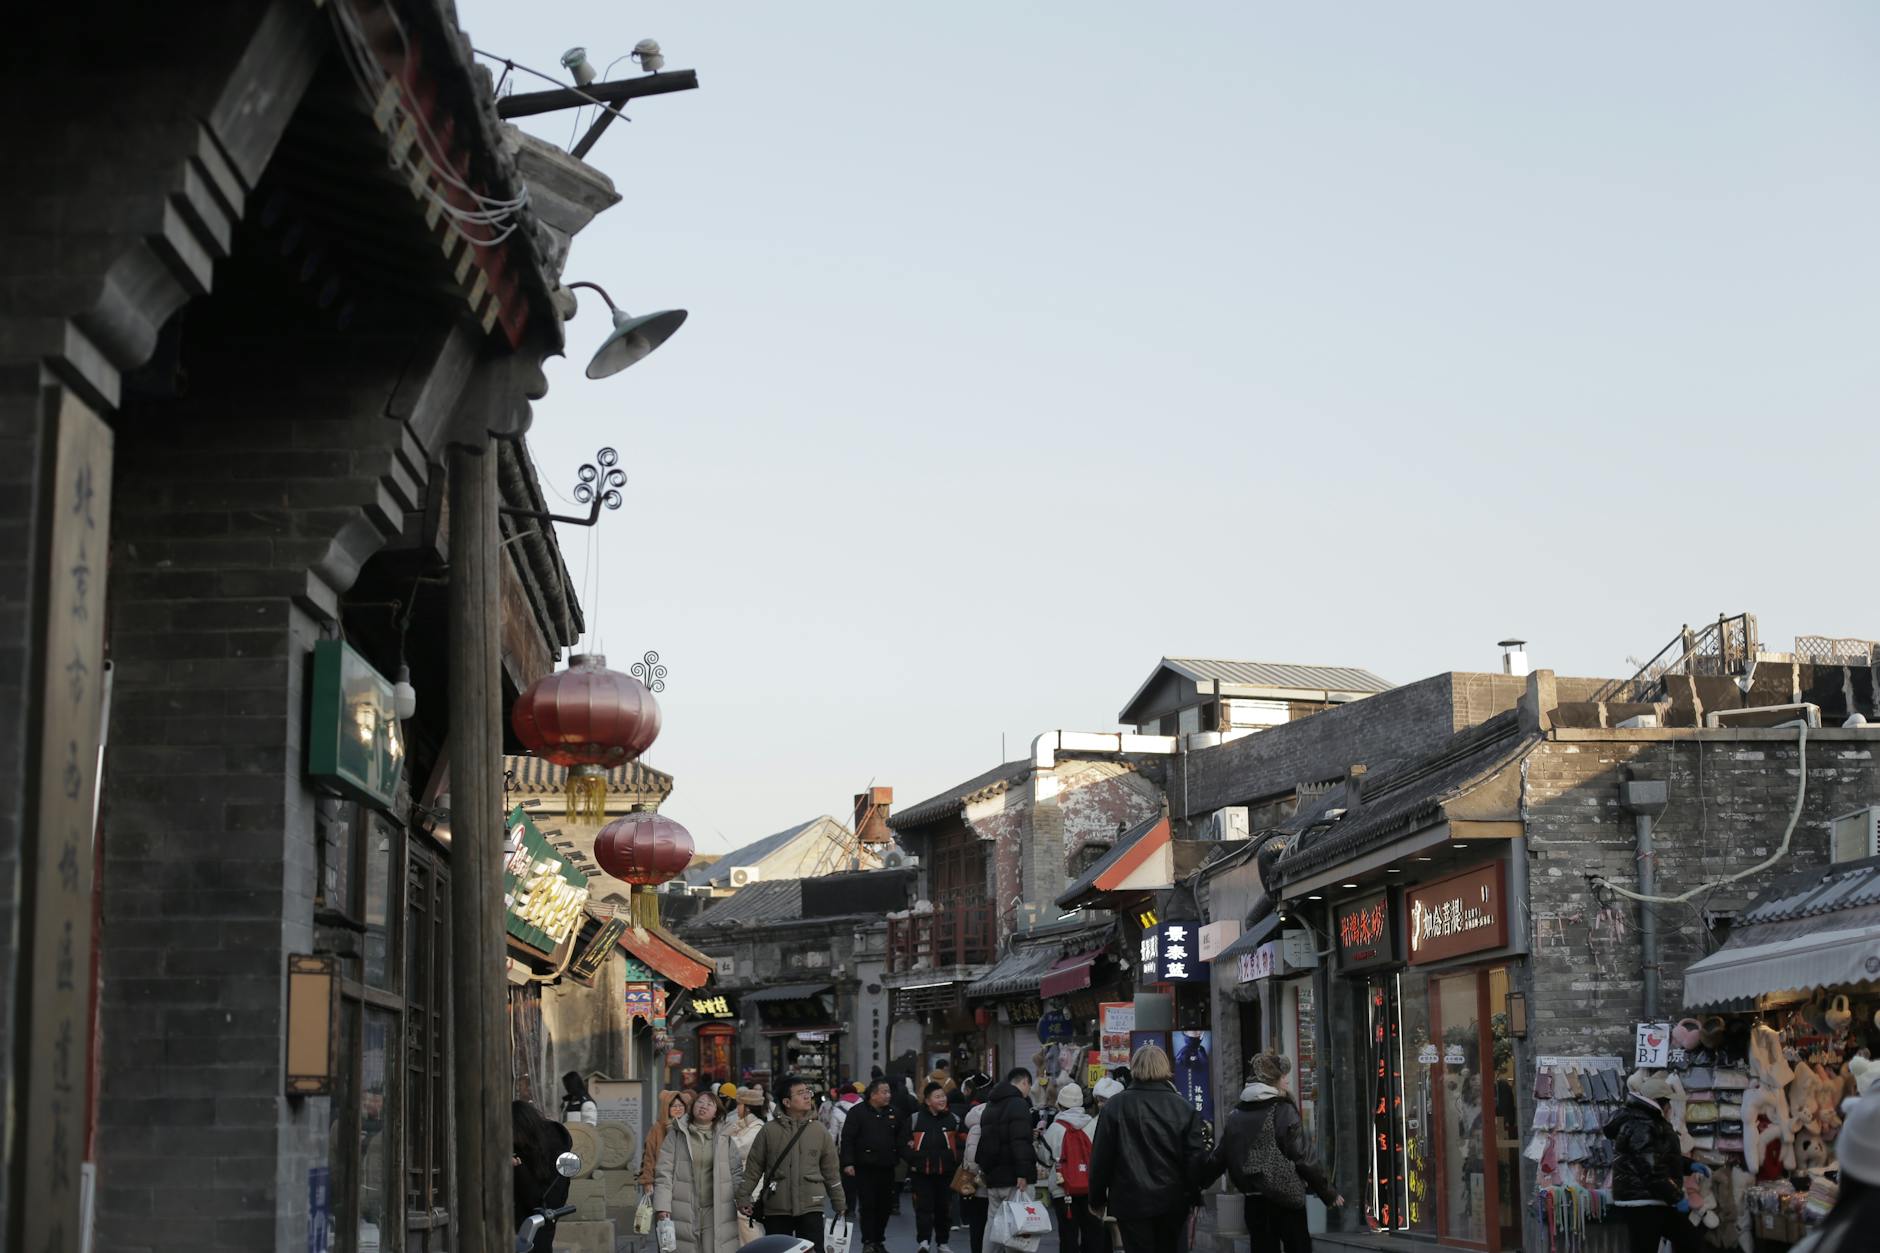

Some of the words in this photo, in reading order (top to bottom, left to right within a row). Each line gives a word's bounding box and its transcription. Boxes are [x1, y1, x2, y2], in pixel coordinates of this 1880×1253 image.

[1164, 926, 1189, 978] 景泰蓝
[1639, 1034, 1646, 1047] I
[1638, 1048, 1659, 1063] BJ
[1668, 1048, 1685, 1063] 京
[1089, 1070, 1097, 1081] 10
